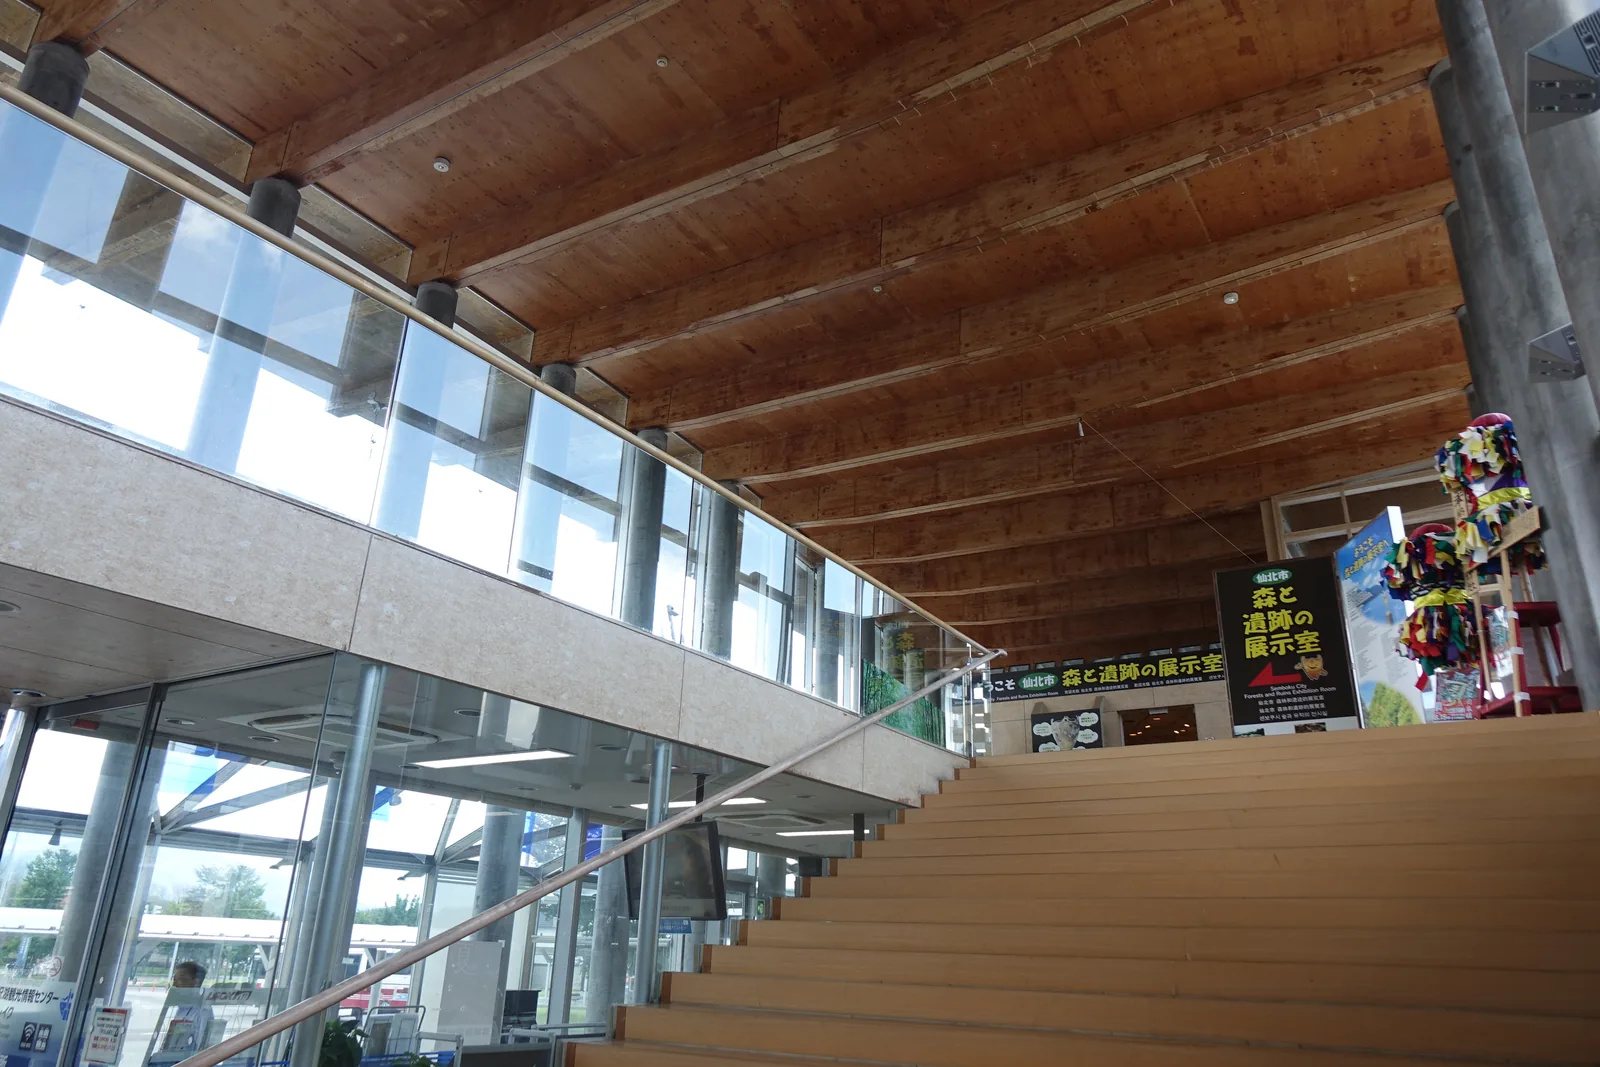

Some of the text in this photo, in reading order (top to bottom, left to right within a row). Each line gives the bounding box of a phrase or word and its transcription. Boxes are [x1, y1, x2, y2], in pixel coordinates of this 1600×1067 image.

[1256, 570, 1289, 584] 仙北市
[1252, 586, 1298, 609] 森と
[1242, 609, 1314, 635] 遺跡の
[1245, 630, 1322, 659] 展示室
[1022, 675, 1056, 688] 仙北市
[1062, 653, 1224, 687] 森と遺跡の展示室
